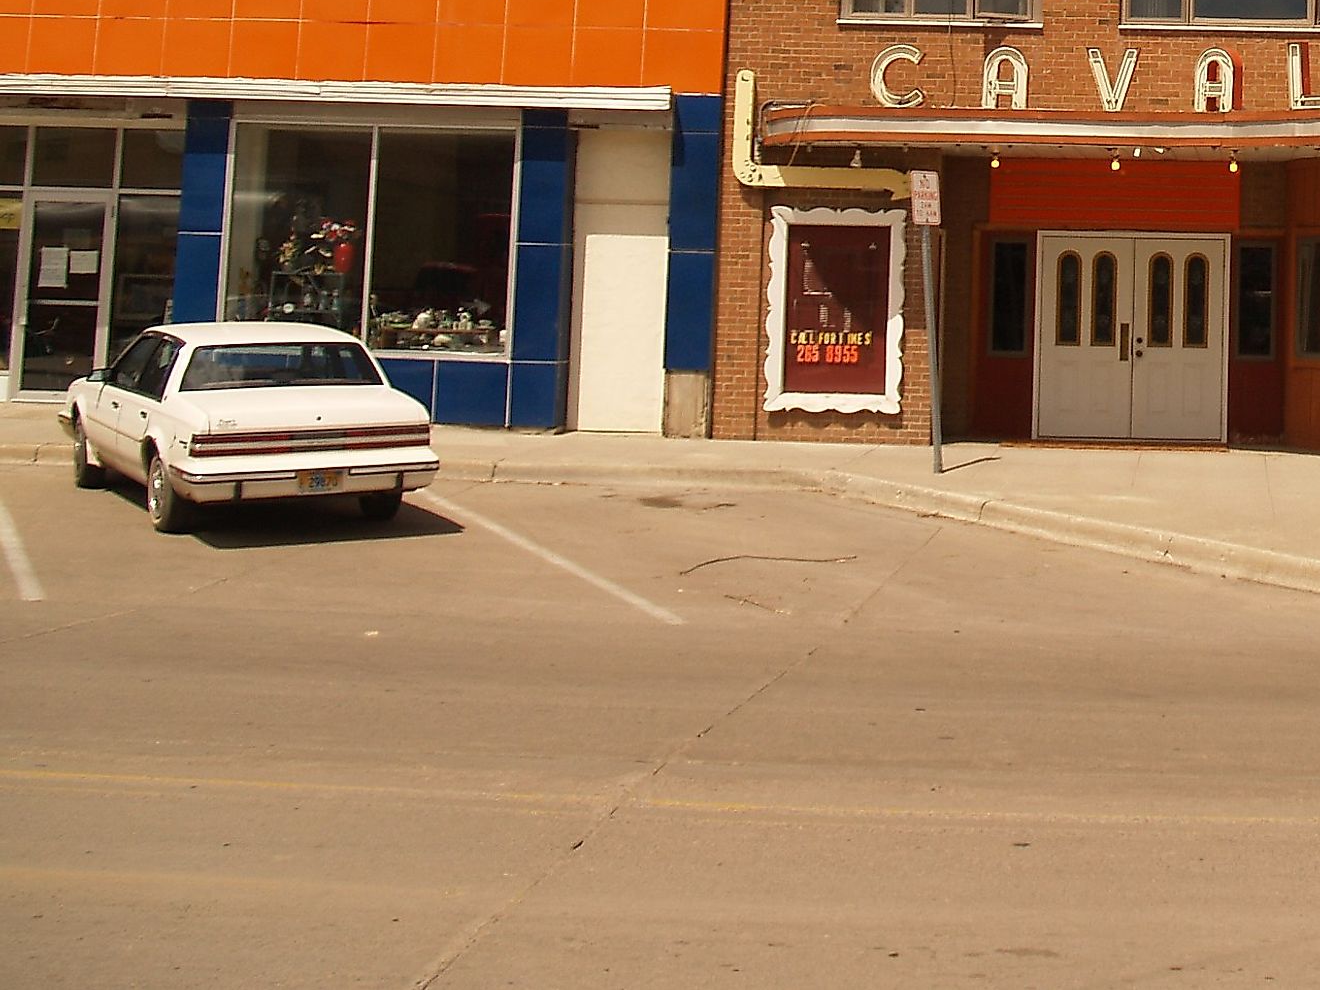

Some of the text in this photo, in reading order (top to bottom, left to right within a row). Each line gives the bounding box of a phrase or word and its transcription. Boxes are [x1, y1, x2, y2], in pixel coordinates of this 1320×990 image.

[790, 331, 816, 345] CALL
[818, 331, 837, 345] FOR
[797, 345, 859, 364] 265 8955
